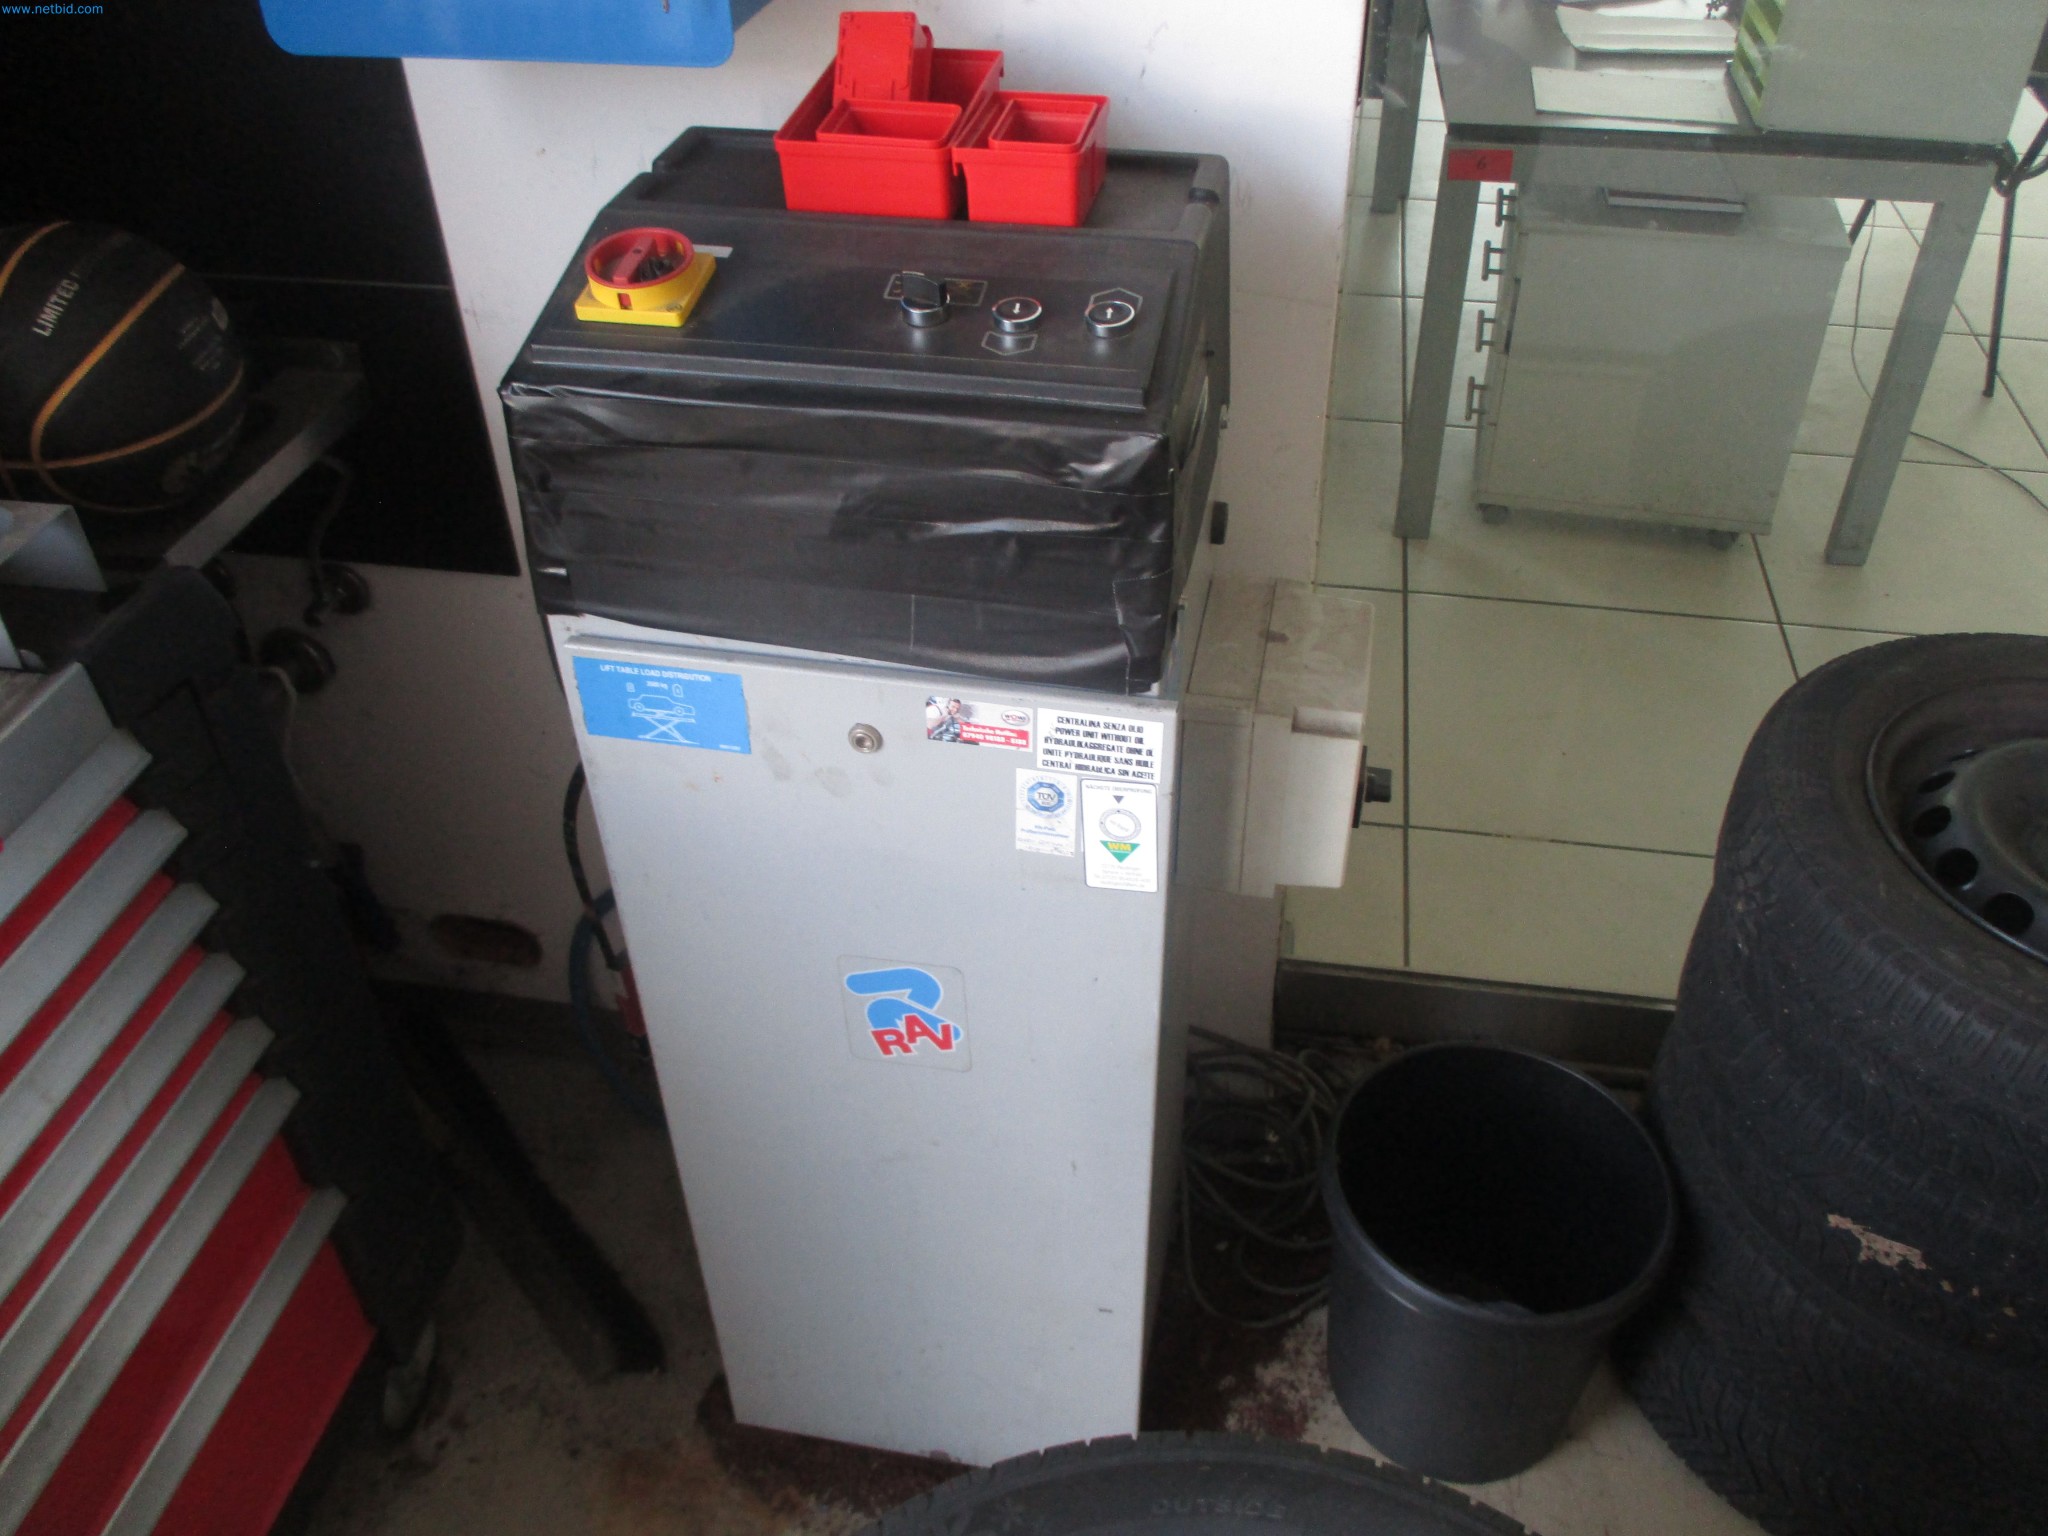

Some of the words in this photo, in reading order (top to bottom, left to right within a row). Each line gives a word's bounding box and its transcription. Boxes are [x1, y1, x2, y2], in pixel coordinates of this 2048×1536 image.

[32, 278, 80, 337] LIMITED
[600, 664, 616, 673] LIFT
[616, 665, 640, 675] TABLE
[640, 668, 661, 678] LOAD
[662, 670, 712, 682] DISTRIBUTION
[1057, 715, 1101, 728] CENTRALINA
[1103, 721, 1126, 731] SENZA
[1128, 724, 1144, 733] OLIO
[1055, 727, 1081, 736] POWER
[1083, 730, 1098, 739] UNIT
[1101, 732, 1132, 743] WITHOUT
[1134, 737, 1145, 745] OIL
[1114, 757, 1133, 765] SANS
[1135, 760, 1154, 769] HUILE
[1118, 769, 1130, 777] SIN
[1131, 771, 1156, 780] ACEITE
[870, 1013, 954, 1057] RAV
